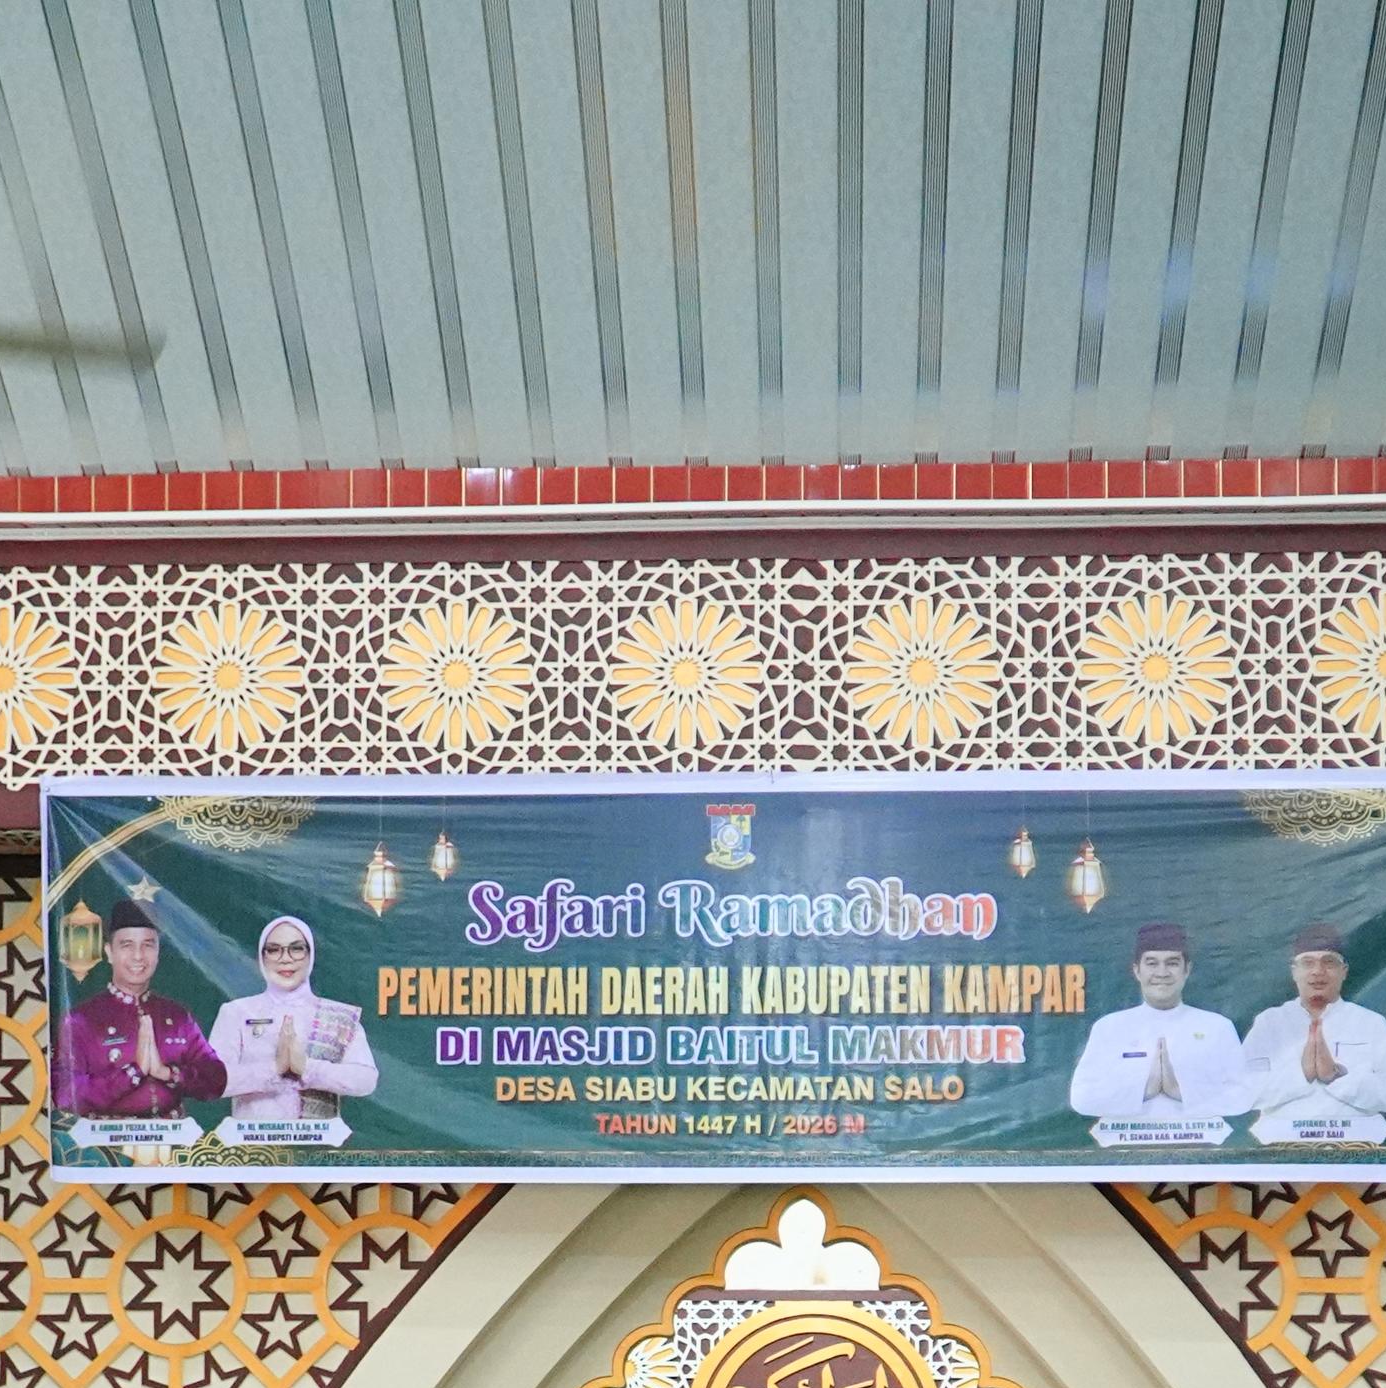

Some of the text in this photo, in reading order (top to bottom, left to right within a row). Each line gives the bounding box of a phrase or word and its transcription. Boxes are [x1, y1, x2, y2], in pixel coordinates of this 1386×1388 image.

[467, 877, 998, 952] Safari Ramadhan
[377, 963, 1087, 1017] PEMERINTAH DAERAH KABUPATEN KAMPAR
[436, 1024, 1026, 1066] DI MASJID BAITUL MAKMUR
[495, 1075, 965, 1102] DESA SIABU KECAMATAN SALO
[595, 1113, 866, 1136] TAHUN 1447 H / 2026 M
